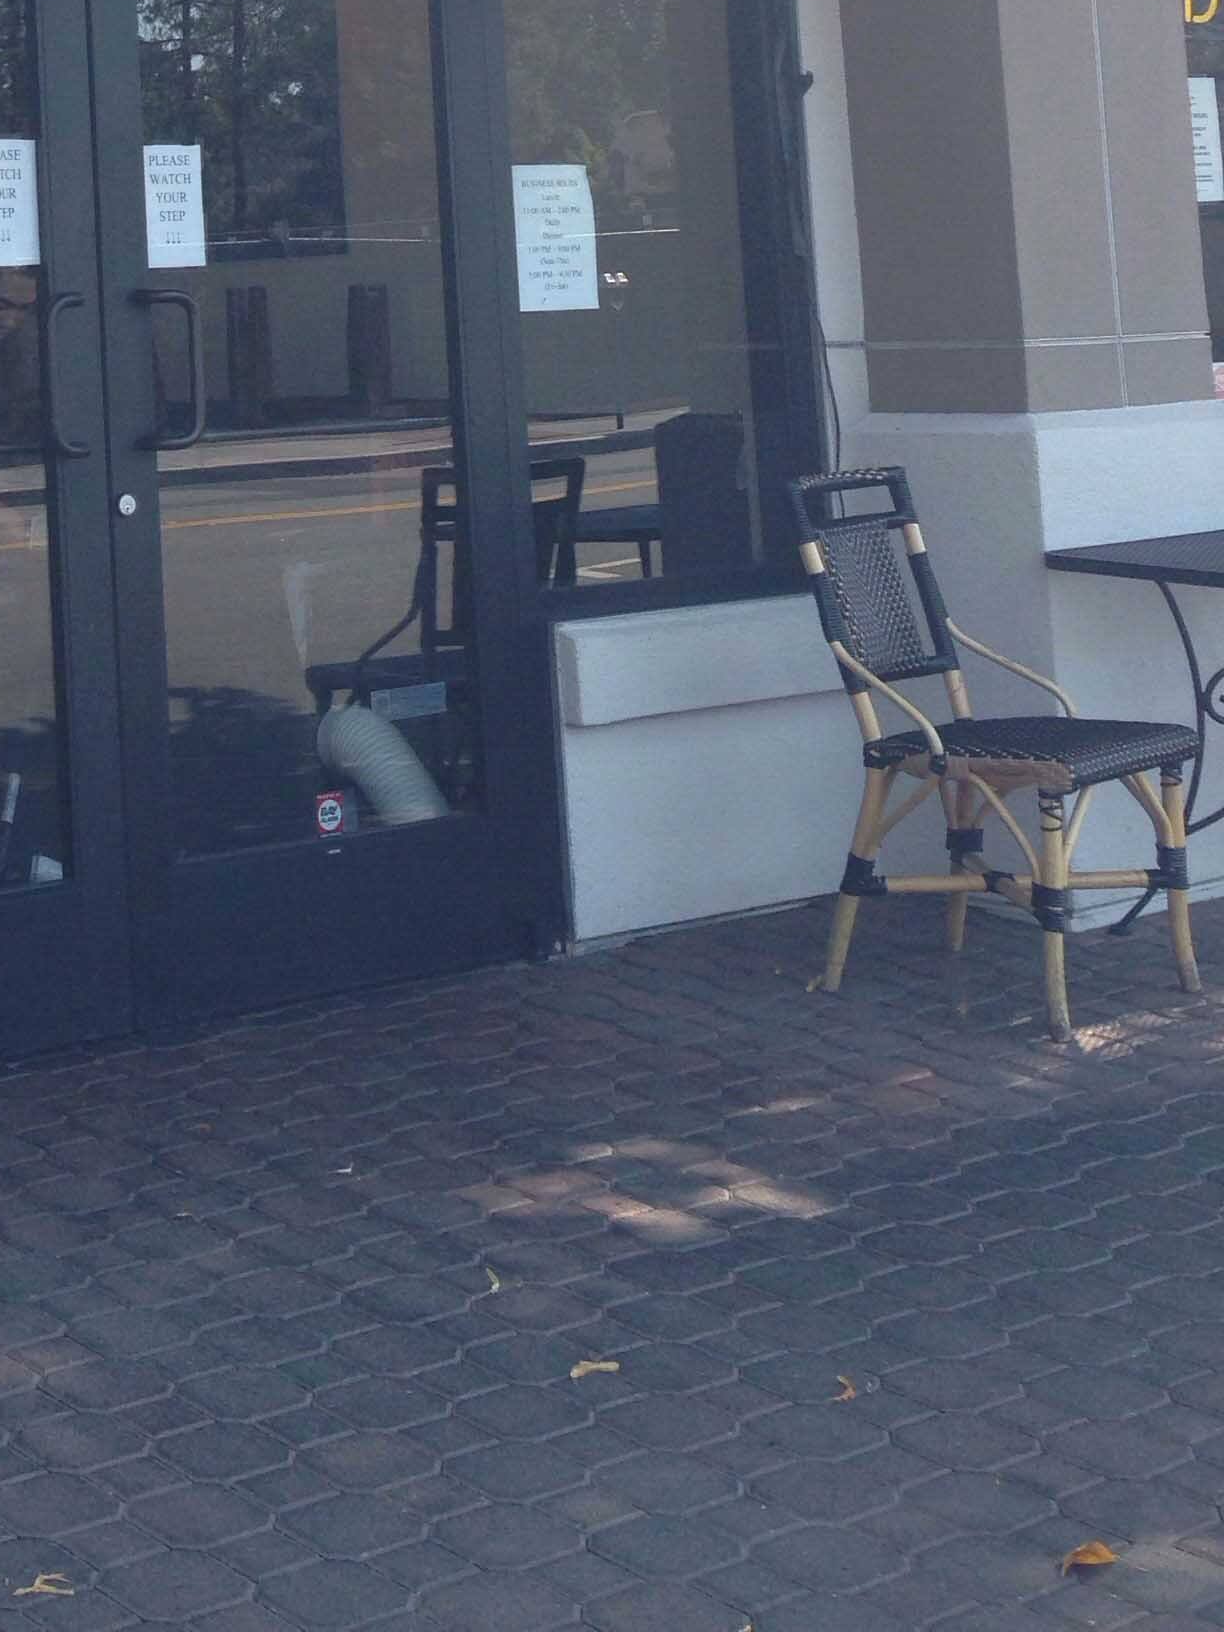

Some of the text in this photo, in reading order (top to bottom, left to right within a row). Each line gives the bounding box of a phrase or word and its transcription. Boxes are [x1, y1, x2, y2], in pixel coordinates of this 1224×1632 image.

[148, 154, 191, 166] PLEASE
[149, 172, 192, 185] WATCH
[155, 192, 188, 203] YOUR
[159, 210, 186, 222] STEP
